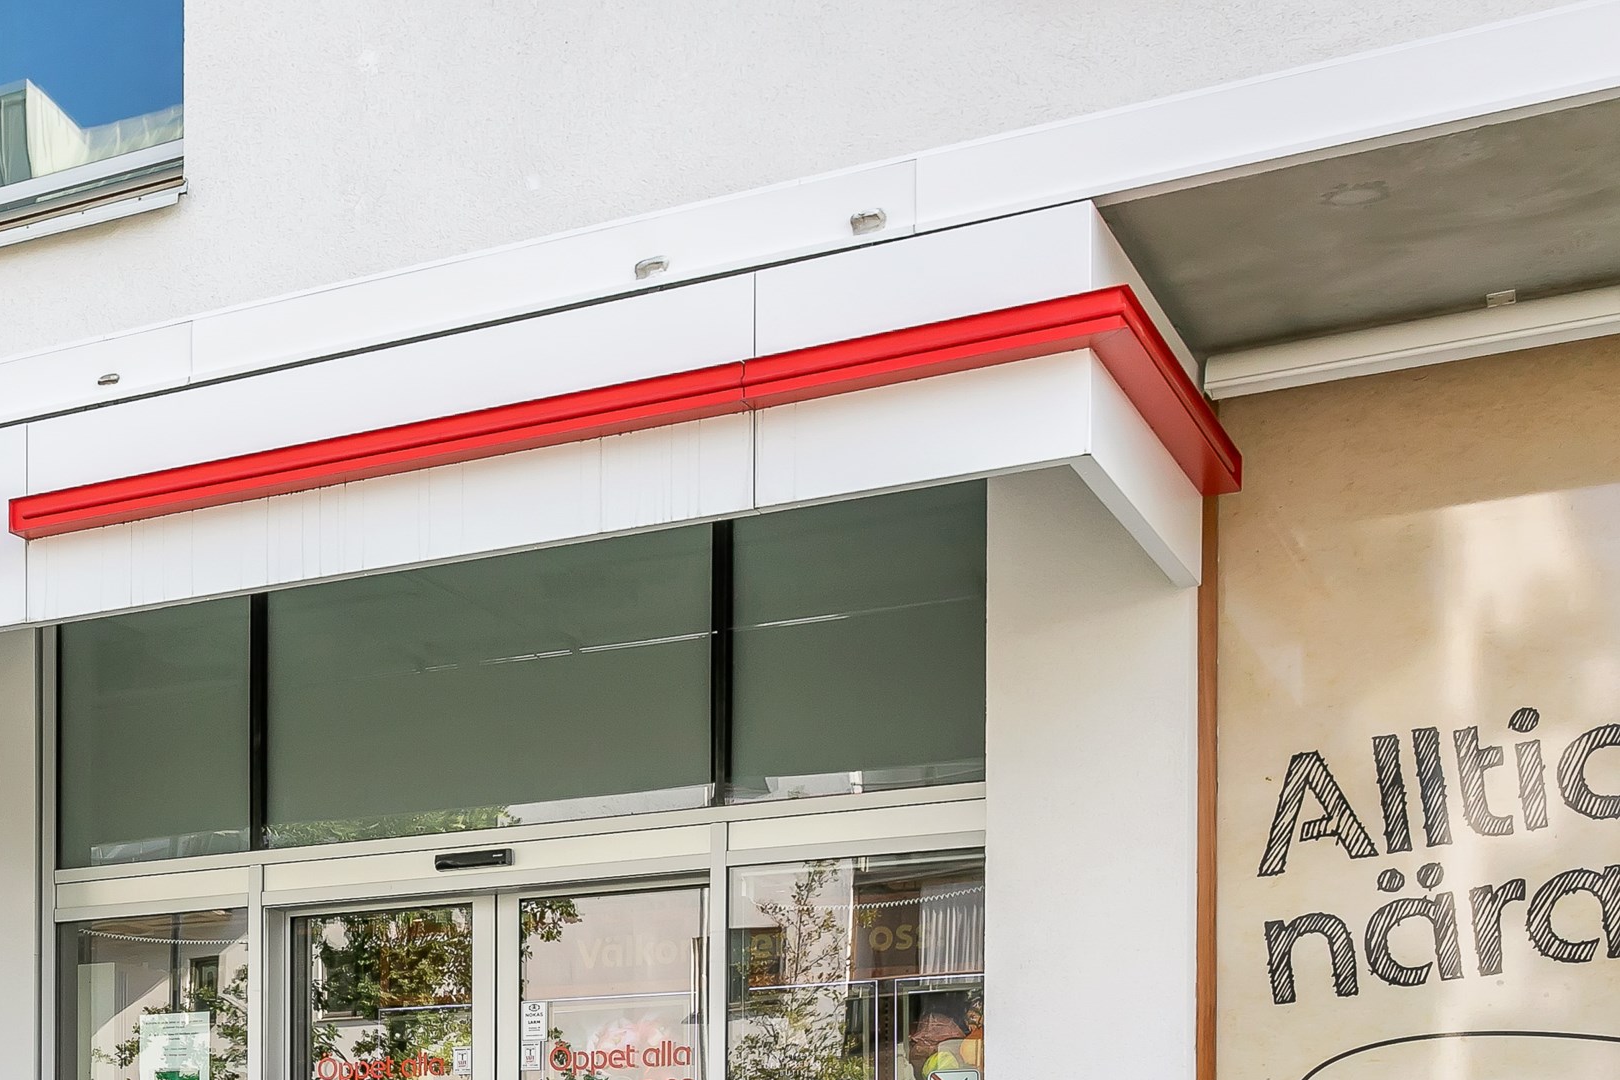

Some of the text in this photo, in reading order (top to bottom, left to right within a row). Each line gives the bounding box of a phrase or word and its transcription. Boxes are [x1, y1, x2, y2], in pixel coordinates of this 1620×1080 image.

[1264, 862, 1620, 1005] nära
[401, 1050, 445, 1079] alla
[549, 1041, 636, 1076] Öppet
[642, 1040, 692, 1068] alla
